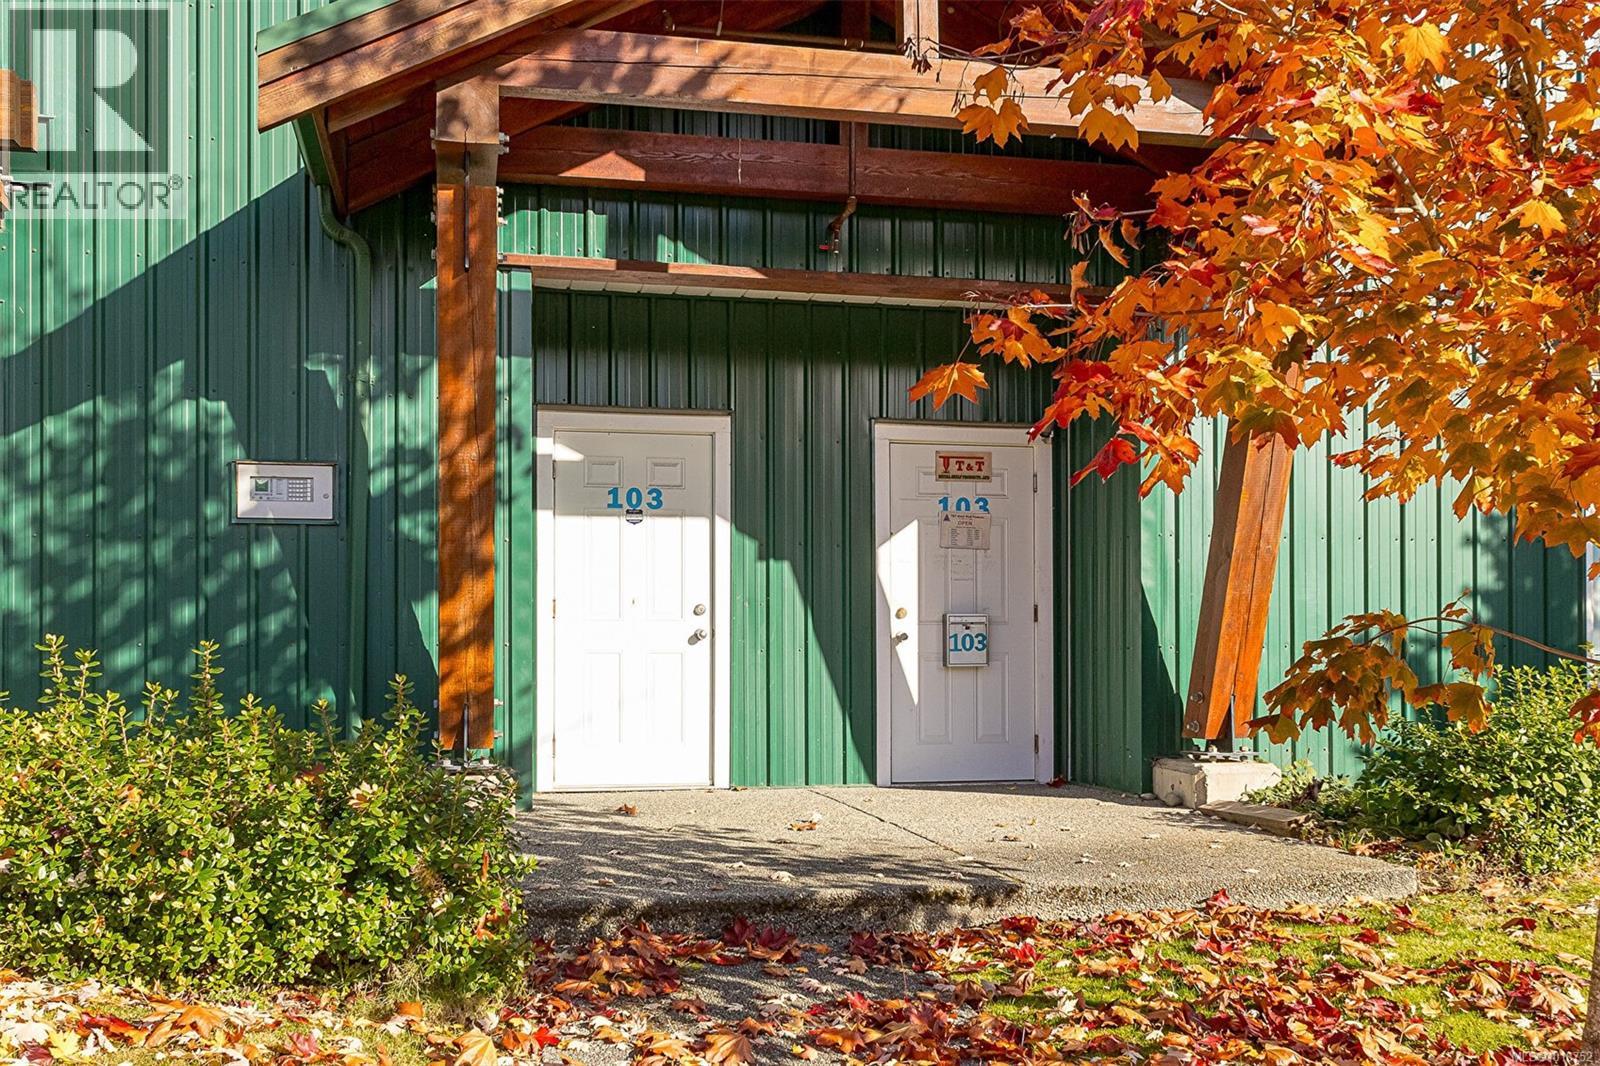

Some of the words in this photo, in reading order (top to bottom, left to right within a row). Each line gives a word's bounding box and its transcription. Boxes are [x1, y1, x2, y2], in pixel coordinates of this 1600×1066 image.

[955, 460, 965, 472] T
[966, 463, 974, 472] &
[975, 461, 985, 472] T
[607, 486, 664, 510] 103
[938, 496, 990, 513] 103
[949, 632, 988, 653] 103
